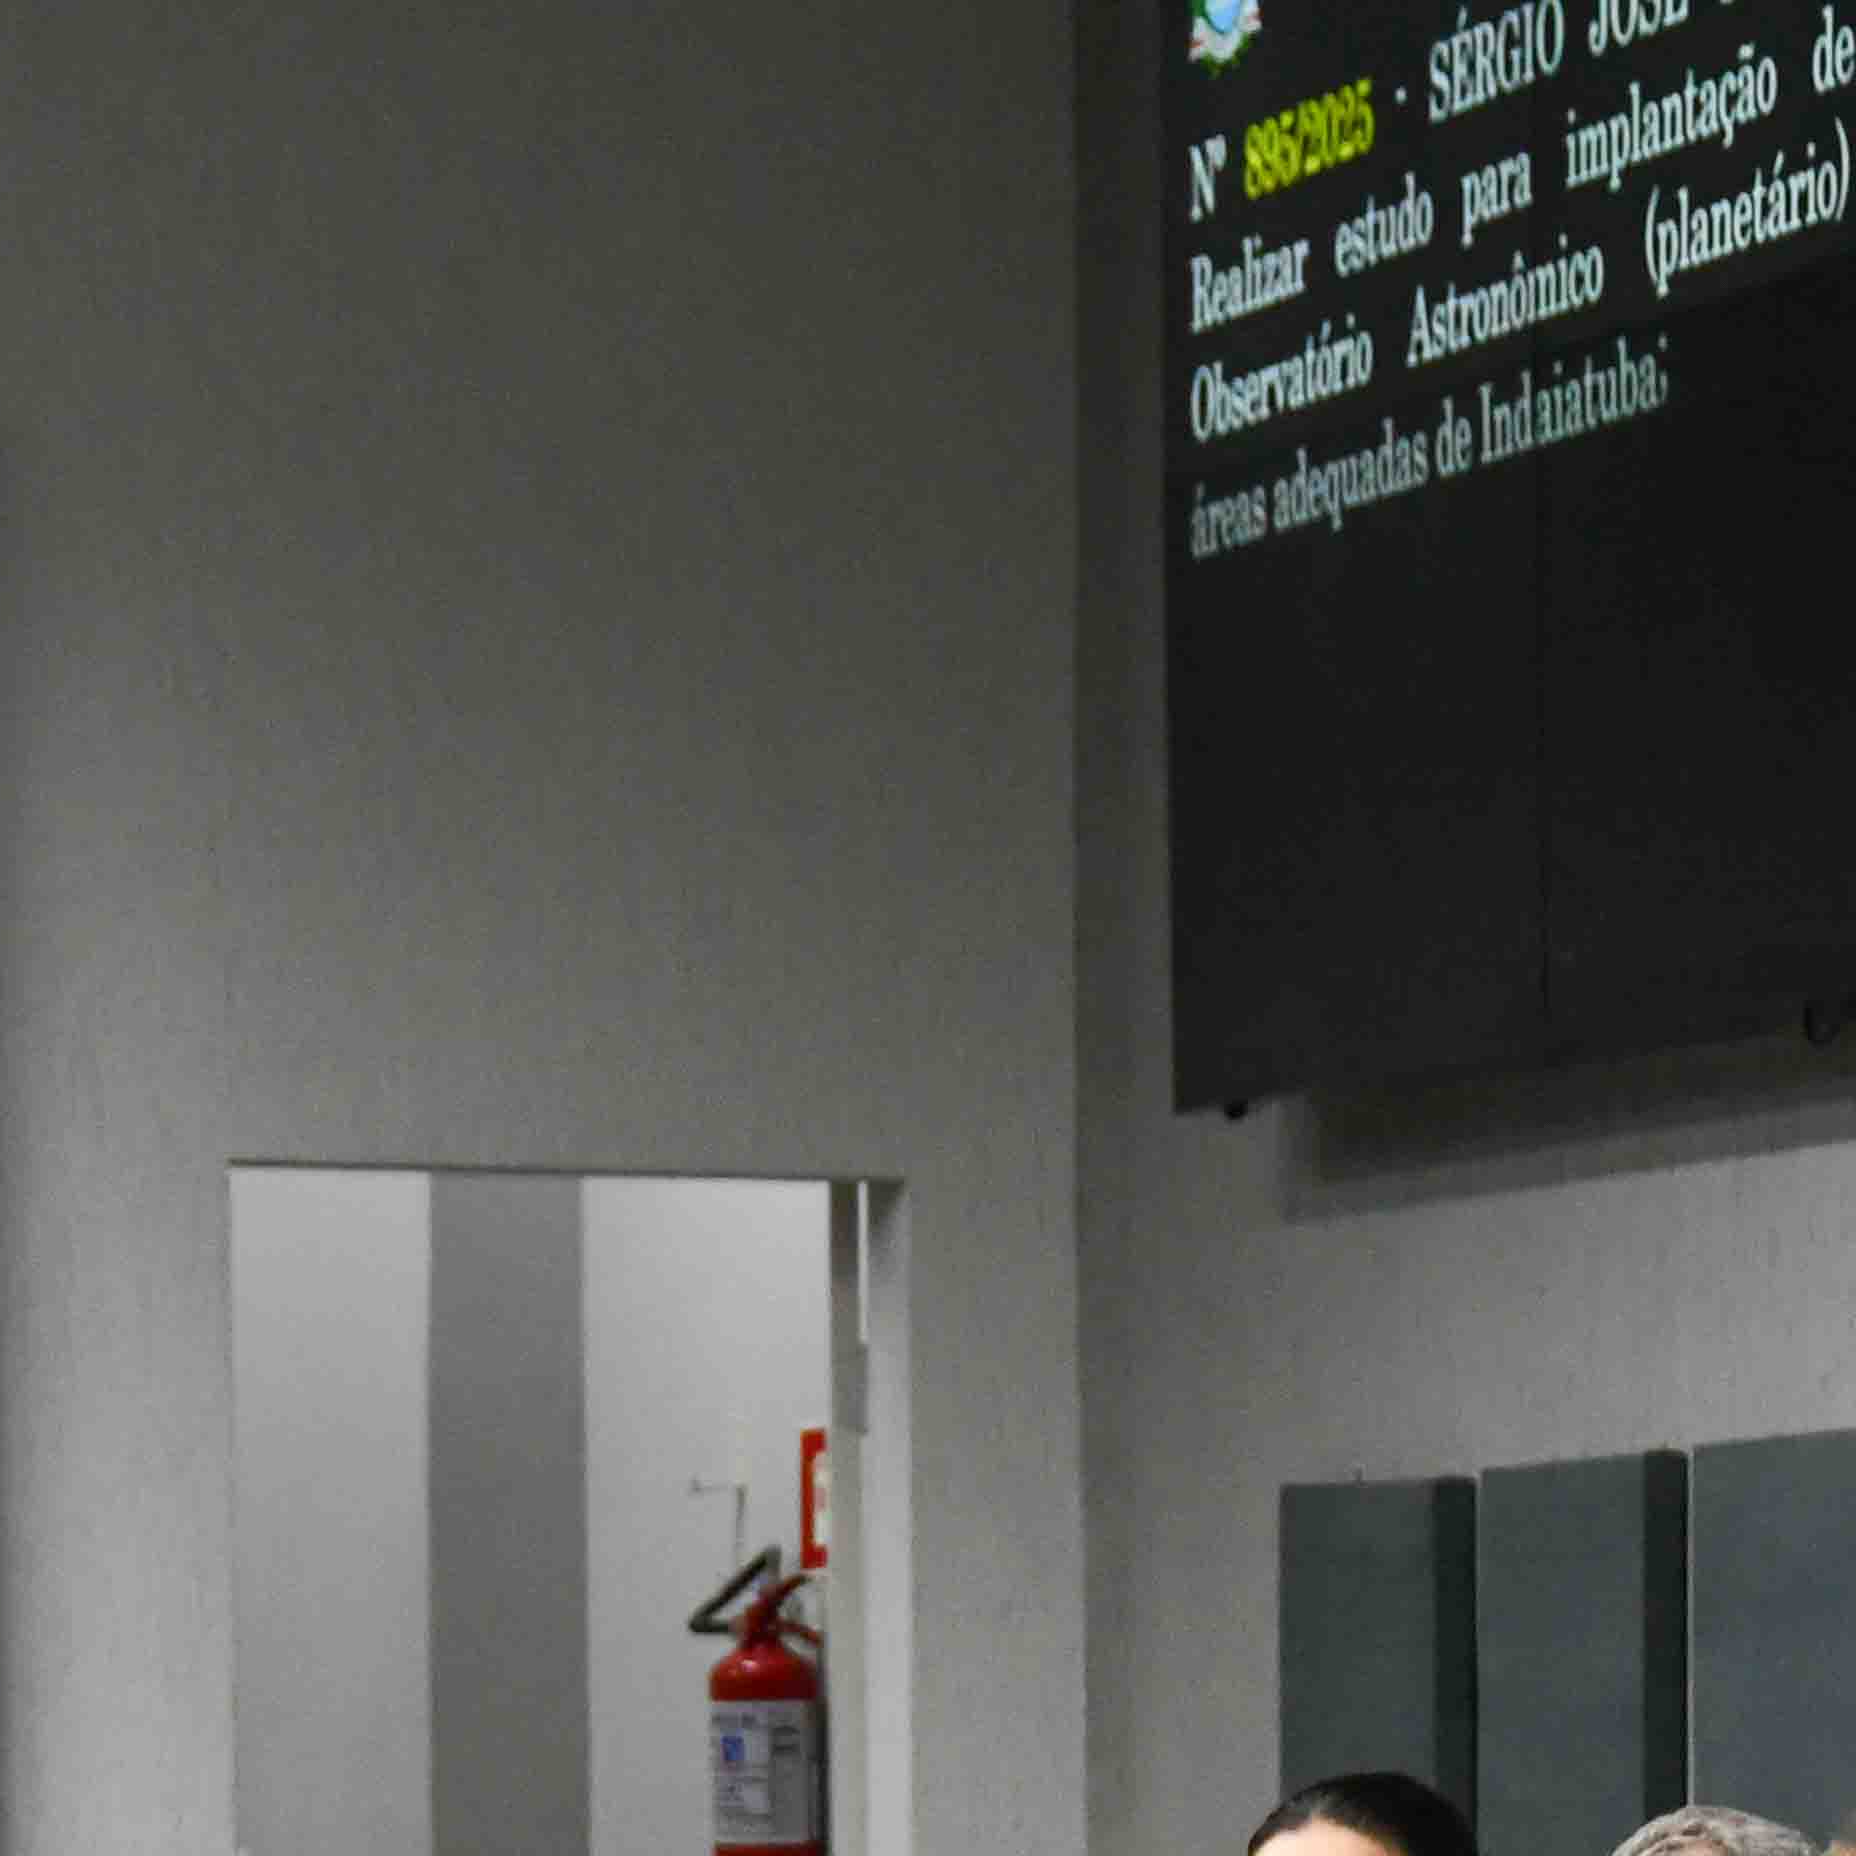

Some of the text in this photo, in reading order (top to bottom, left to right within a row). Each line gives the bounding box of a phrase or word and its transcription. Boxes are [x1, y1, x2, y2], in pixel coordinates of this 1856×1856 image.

[1189, 233, 1311, 335] Realizar
[1334, 170, 1434, 278] estudo
[1459, 150, 1534, 248] para
[1564, 42, 1779, 192] implantação
[1811, 4, 1856, 94] de
[1428, 0, 1565, 124] SÉRGIO
[1190, 311, 1375, 444] Observatório
[1405, 233, 1605, 368] Astronômico
[1645, 115, 1851, 299] (planetário)
[1191, 332, 1669, 562] áreas adequadas de Indaiatuba;
